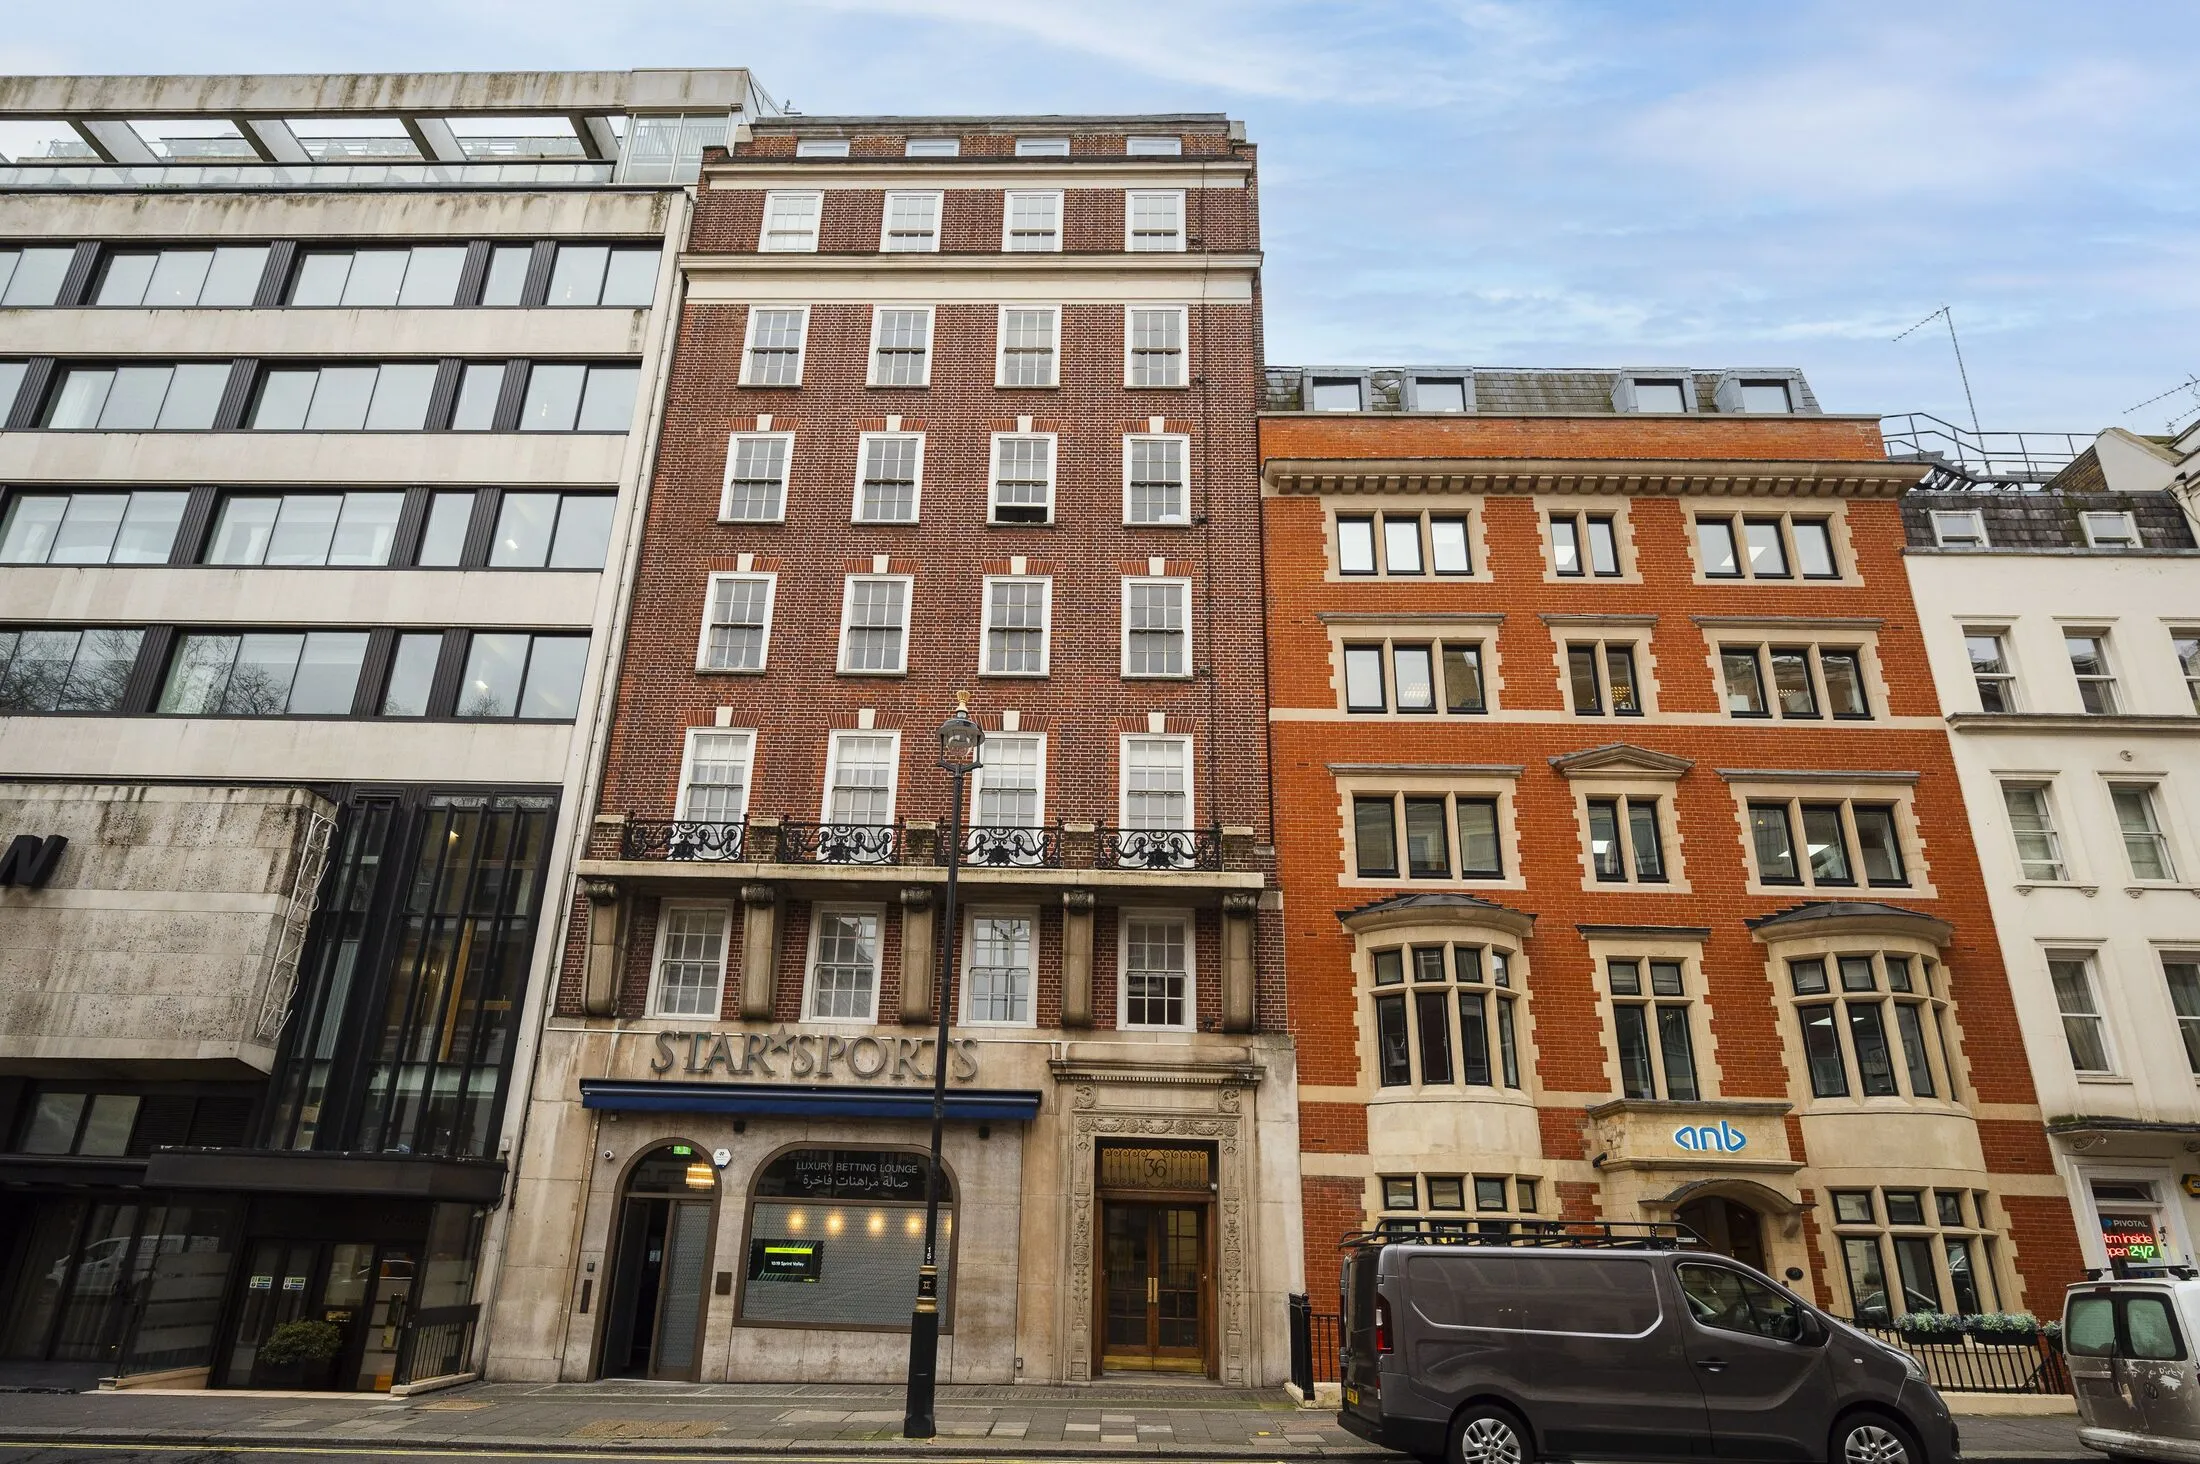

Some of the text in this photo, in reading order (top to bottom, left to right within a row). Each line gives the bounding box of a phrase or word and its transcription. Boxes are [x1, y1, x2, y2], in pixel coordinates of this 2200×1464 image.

[0, 834, 69, 888] N
[650, 1029, 978, 1080] STAR SPORTS
[1674, 1119, 1748, 1152] anb
[796, 1161, 918, 1174] LUXURY BETTING LOUNGE
[1144, 1158, 1168, 1178] 36
[802, 1174, 909, 1191] صالة مراهنات فاخرة
[2113, 1219, 2149, 1228] PIVOTAL
[2121, 1233, 2154, 1245] inside
